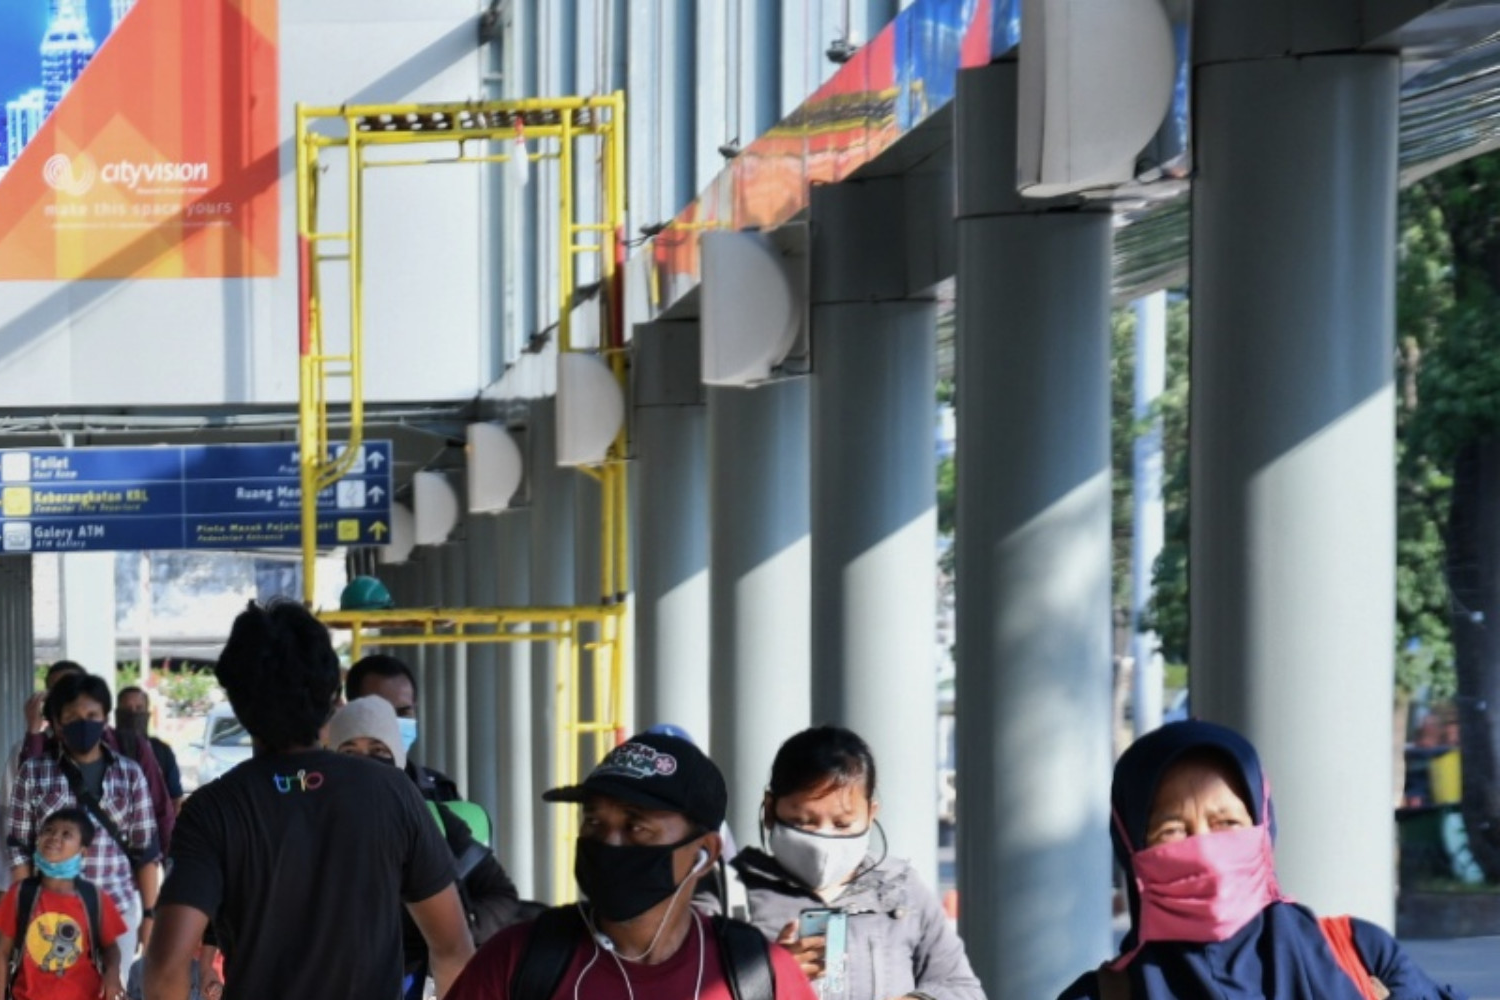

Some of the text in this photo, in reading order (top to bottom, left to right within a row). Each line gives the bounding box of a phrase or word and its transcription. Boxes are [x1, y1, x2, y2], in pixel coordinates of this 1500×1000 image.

[101, 160, 208, 189] cityvision
[94, 201, 127, 216] this
[132, 202, 181, 218] space
[186, 202, 233, 218] yours
[236, 486, 273, 502] Ruang
[34, 524, 105, 541] Galery ATM
